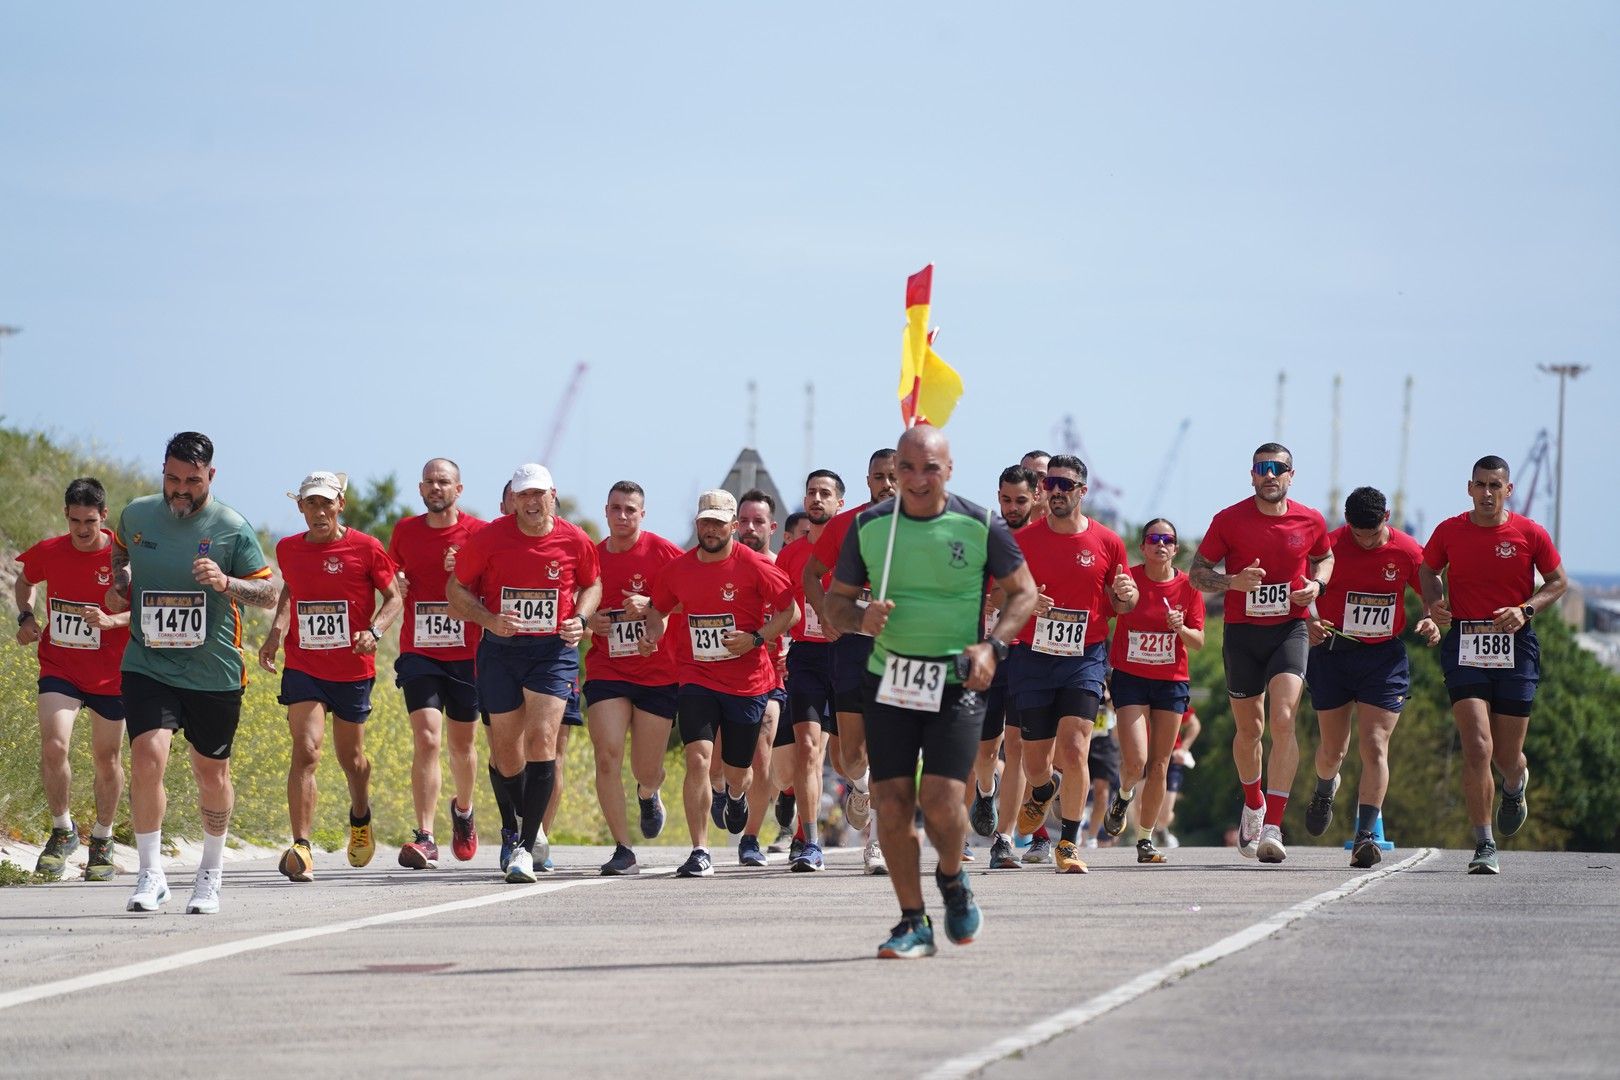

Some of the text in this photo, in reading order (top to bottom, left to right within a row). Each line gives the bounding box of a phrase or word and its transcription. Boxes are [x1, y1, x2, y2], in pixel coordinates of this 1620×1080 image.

[1250, 585, 1287, 604] 1505
[154, 608, 202, 632] 1470
[514, 600, 554, 620] 1043
[1353, 606, 1390, 625] 1770
[308, 615, 344, 635] 1281
[425, 616, 461, 634] 1543
[616, 622, 647, 643] 146
[1046, 621, 1083, 643] 1318
[1139, 634, 1174, 652] 2213
[1472, 635, 1511, 655] 1588
[891, 658, 940, 691] 1143
